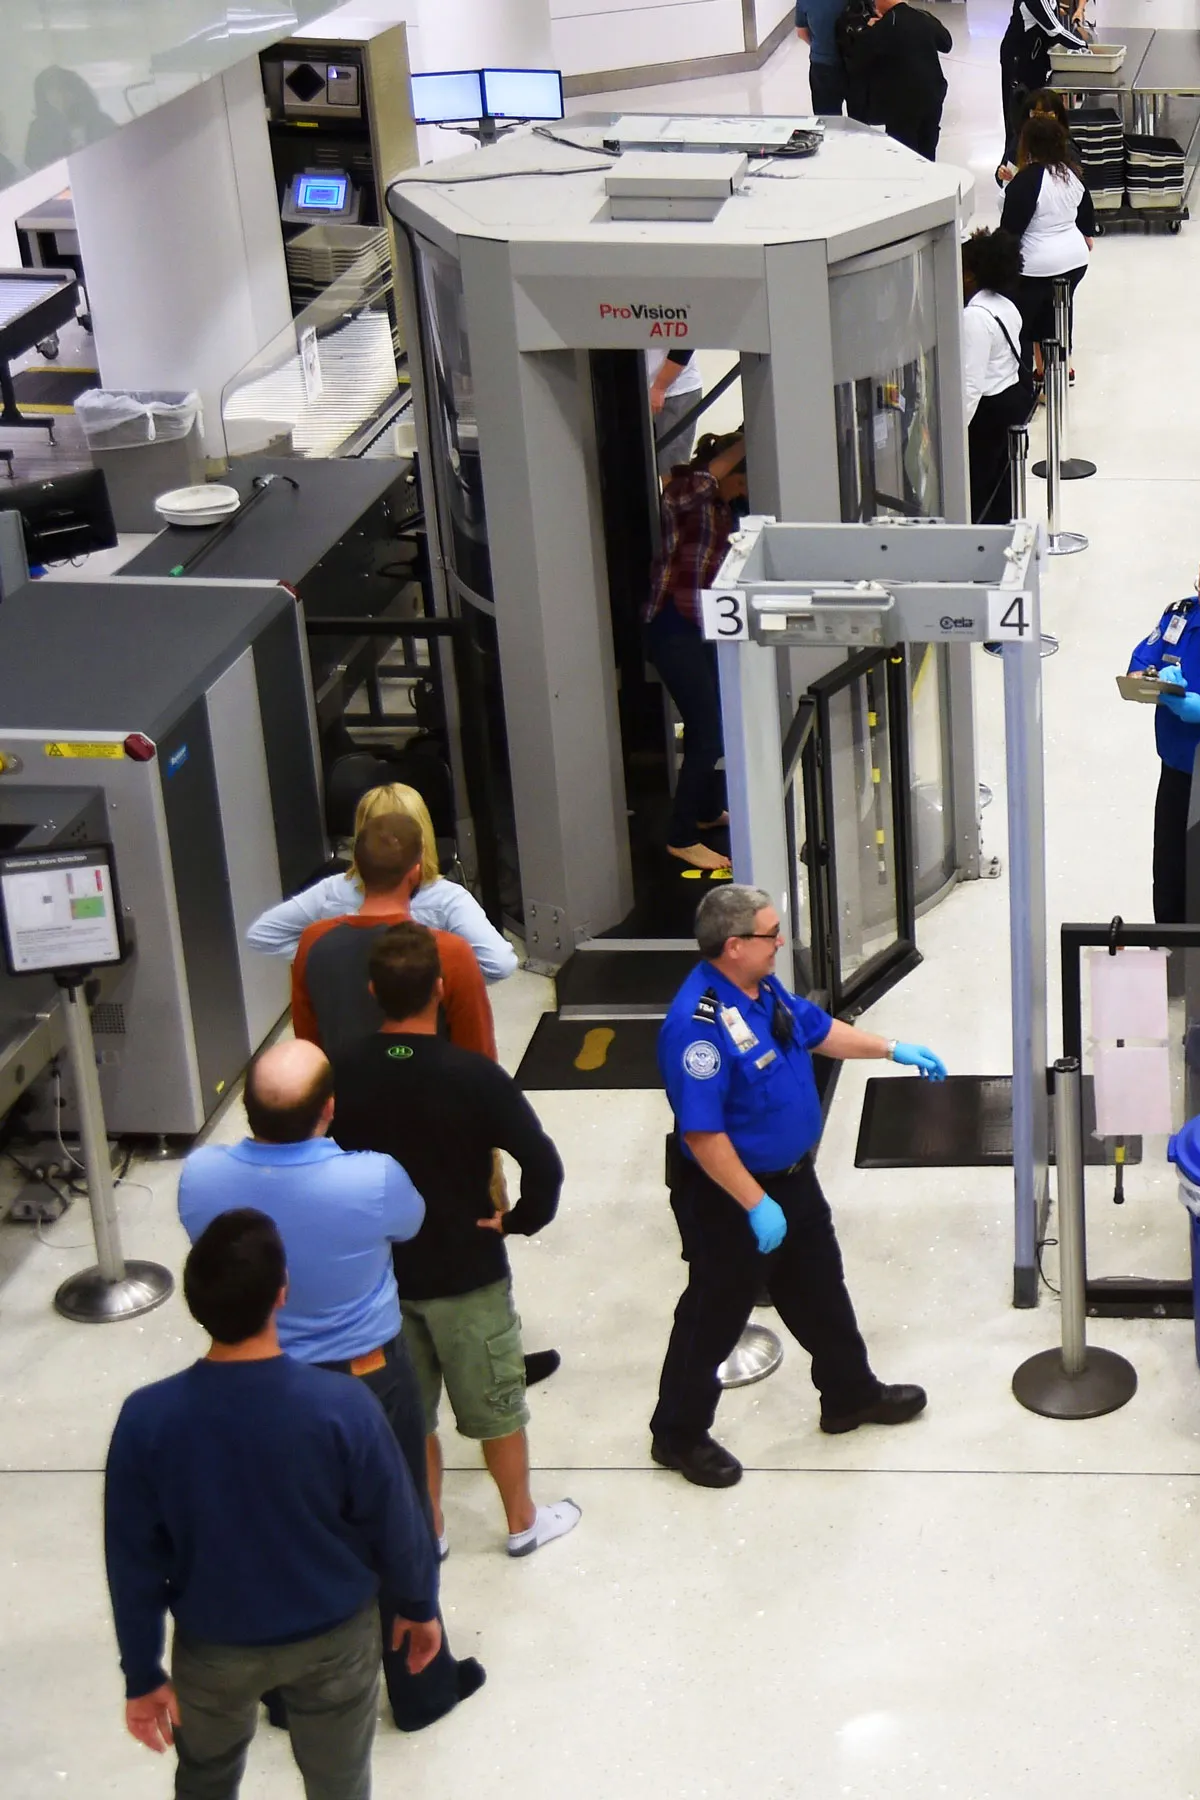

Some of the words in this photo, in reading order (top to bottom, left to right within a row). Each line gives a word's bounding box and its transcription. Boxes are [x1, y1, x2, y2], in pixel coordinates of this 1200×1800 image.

[599, 303, 688, 319] ProVision
[650, 321, 688, 337] ATD
[715, 595, 744, 636] 3
[999, 596, 1030, 637] 4
[698, 1002, 715, 1013] TSA
